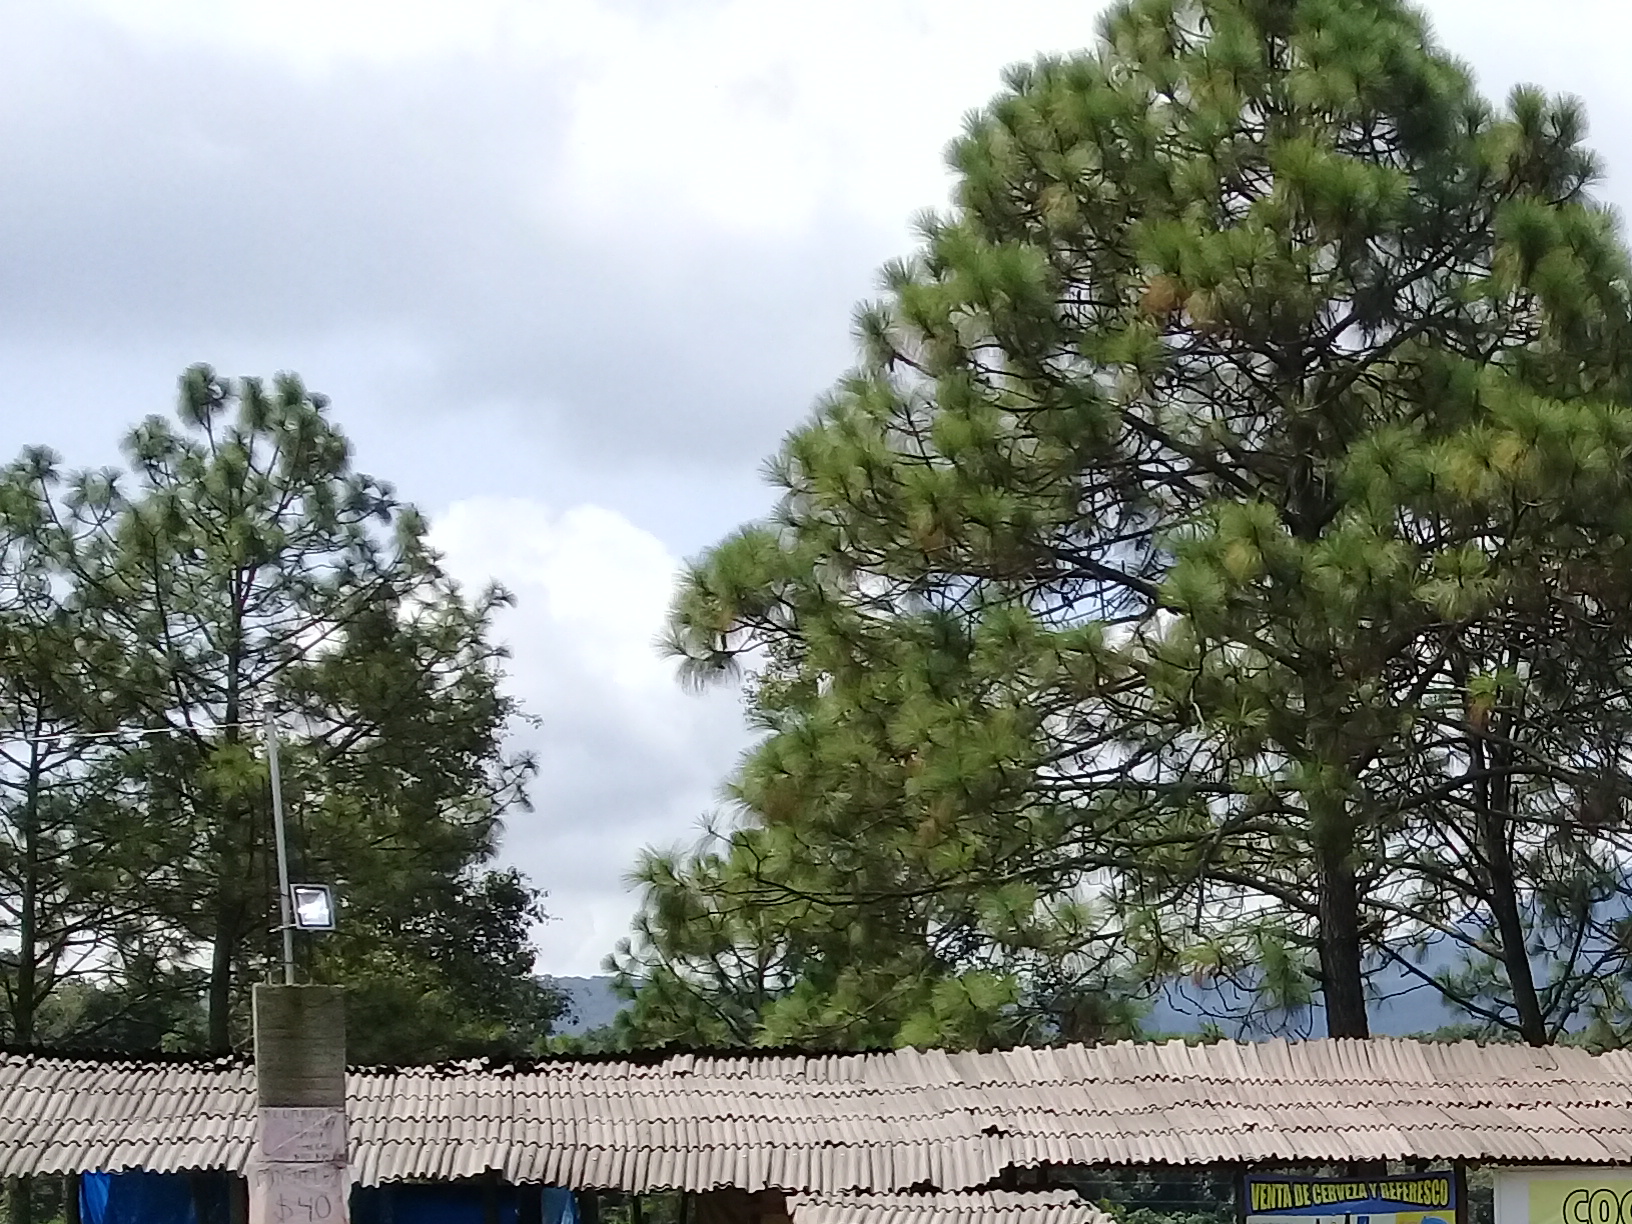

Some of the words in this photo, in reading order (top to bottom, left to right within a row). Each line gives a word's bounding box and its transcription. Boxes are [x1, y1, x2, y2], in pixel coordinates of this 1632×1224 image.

[1251, 1182, 1292, 1211] VENTA
[1294, 1182, 1311, 1206] DE
[1312, 1182, 1367, 1204] CERVEZA
[1369, 1183, 1377, 1198] Y
